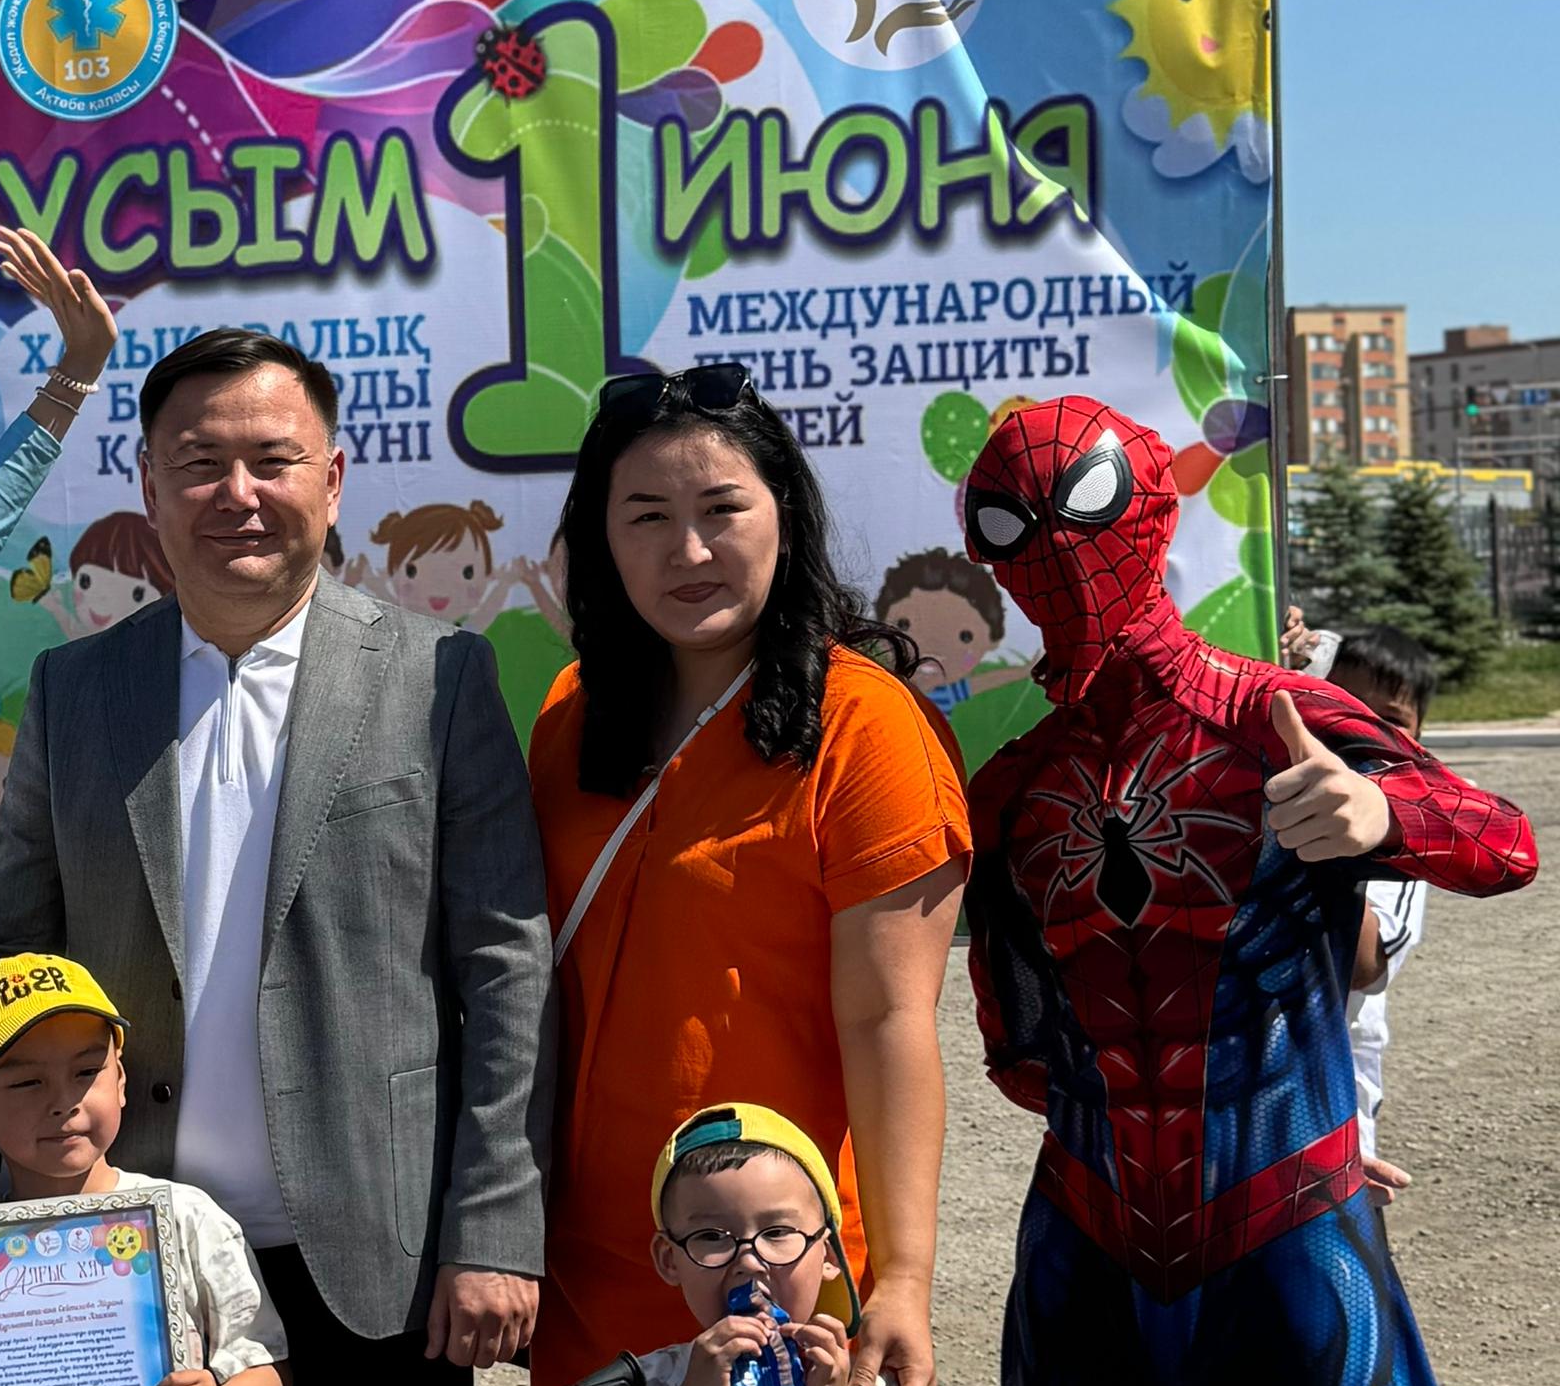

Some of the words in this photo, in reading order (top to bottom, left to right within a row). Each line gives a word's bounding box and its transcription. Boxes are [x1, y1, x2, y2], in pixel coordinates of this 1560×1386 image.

[64, 56, 111, 82] 103
[655, 97, 1098, 249] ИЮНЯ
[687, 261, 1197, 340] МЕЖДУНАРОДНЫЙ
[850, 334, 1090, 391] ЗАЩИТЫ
[335, 420, 432, 464] ҮНІ
